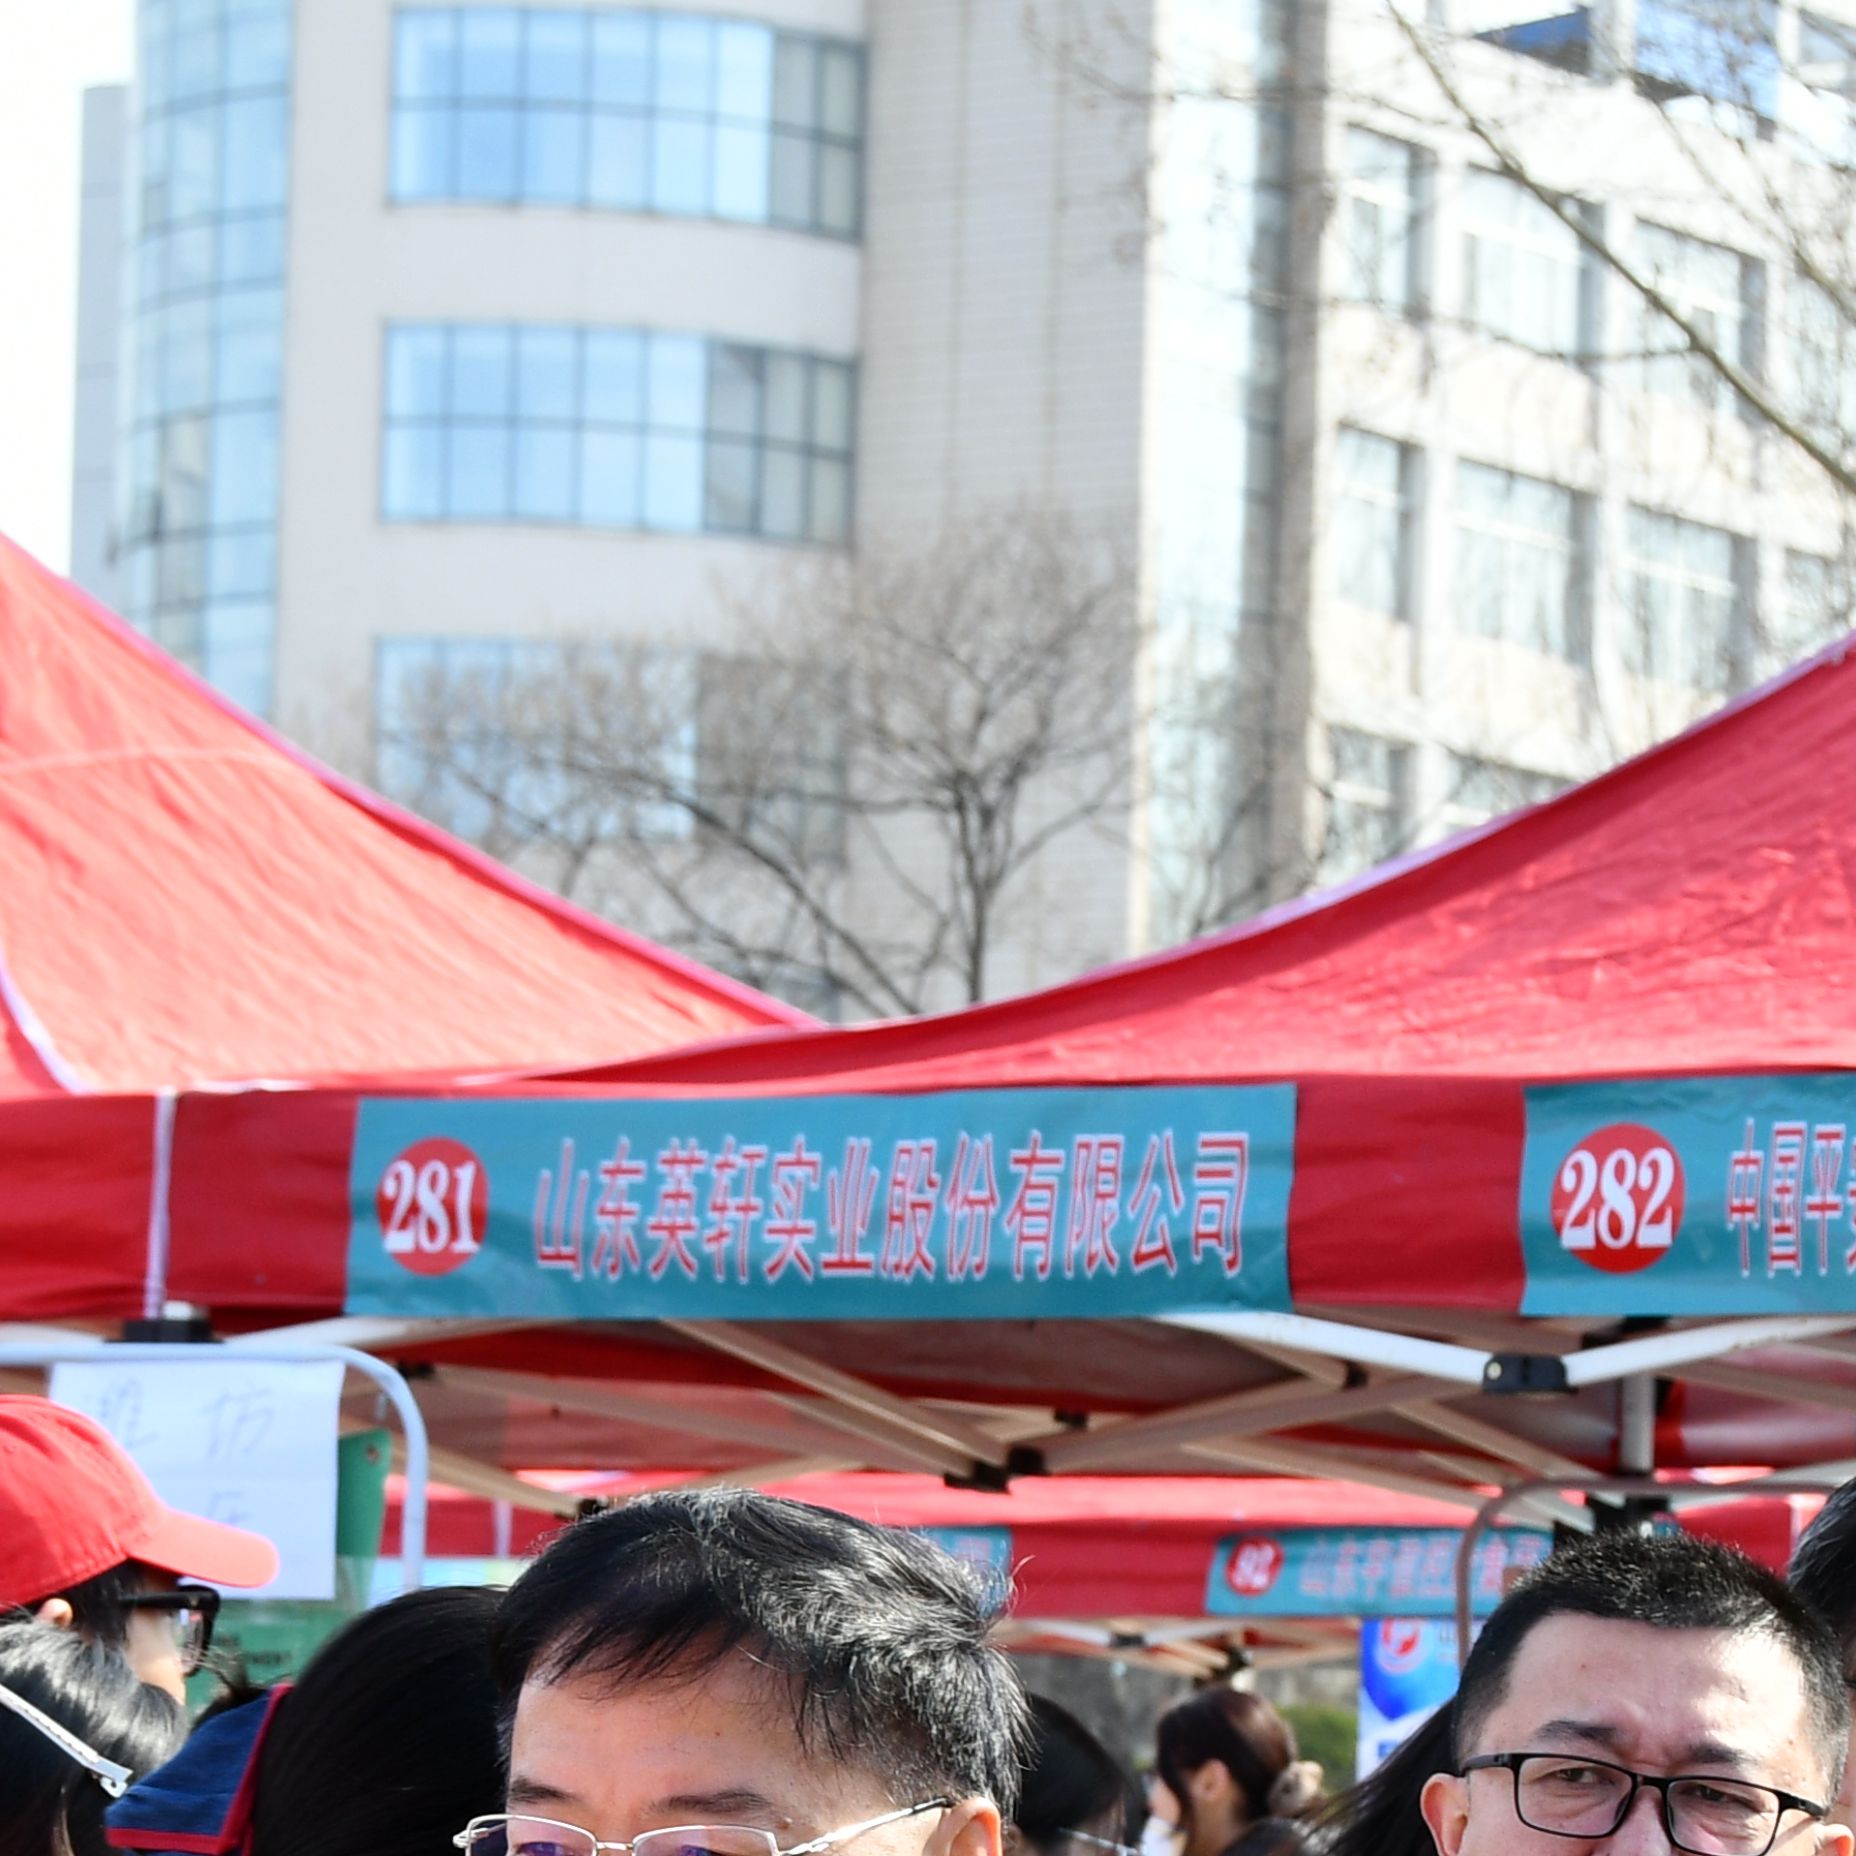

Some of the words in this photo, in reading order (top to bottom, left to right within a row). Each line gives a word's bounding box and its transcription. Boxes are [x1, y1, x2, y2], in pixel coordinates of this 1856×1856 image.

[380, 1159, 480, 1255] 281
[532, 1128, 1252, 1282] 山东英轩实业股份有限公司
[1559, 1147, 1675, 1251] 282
